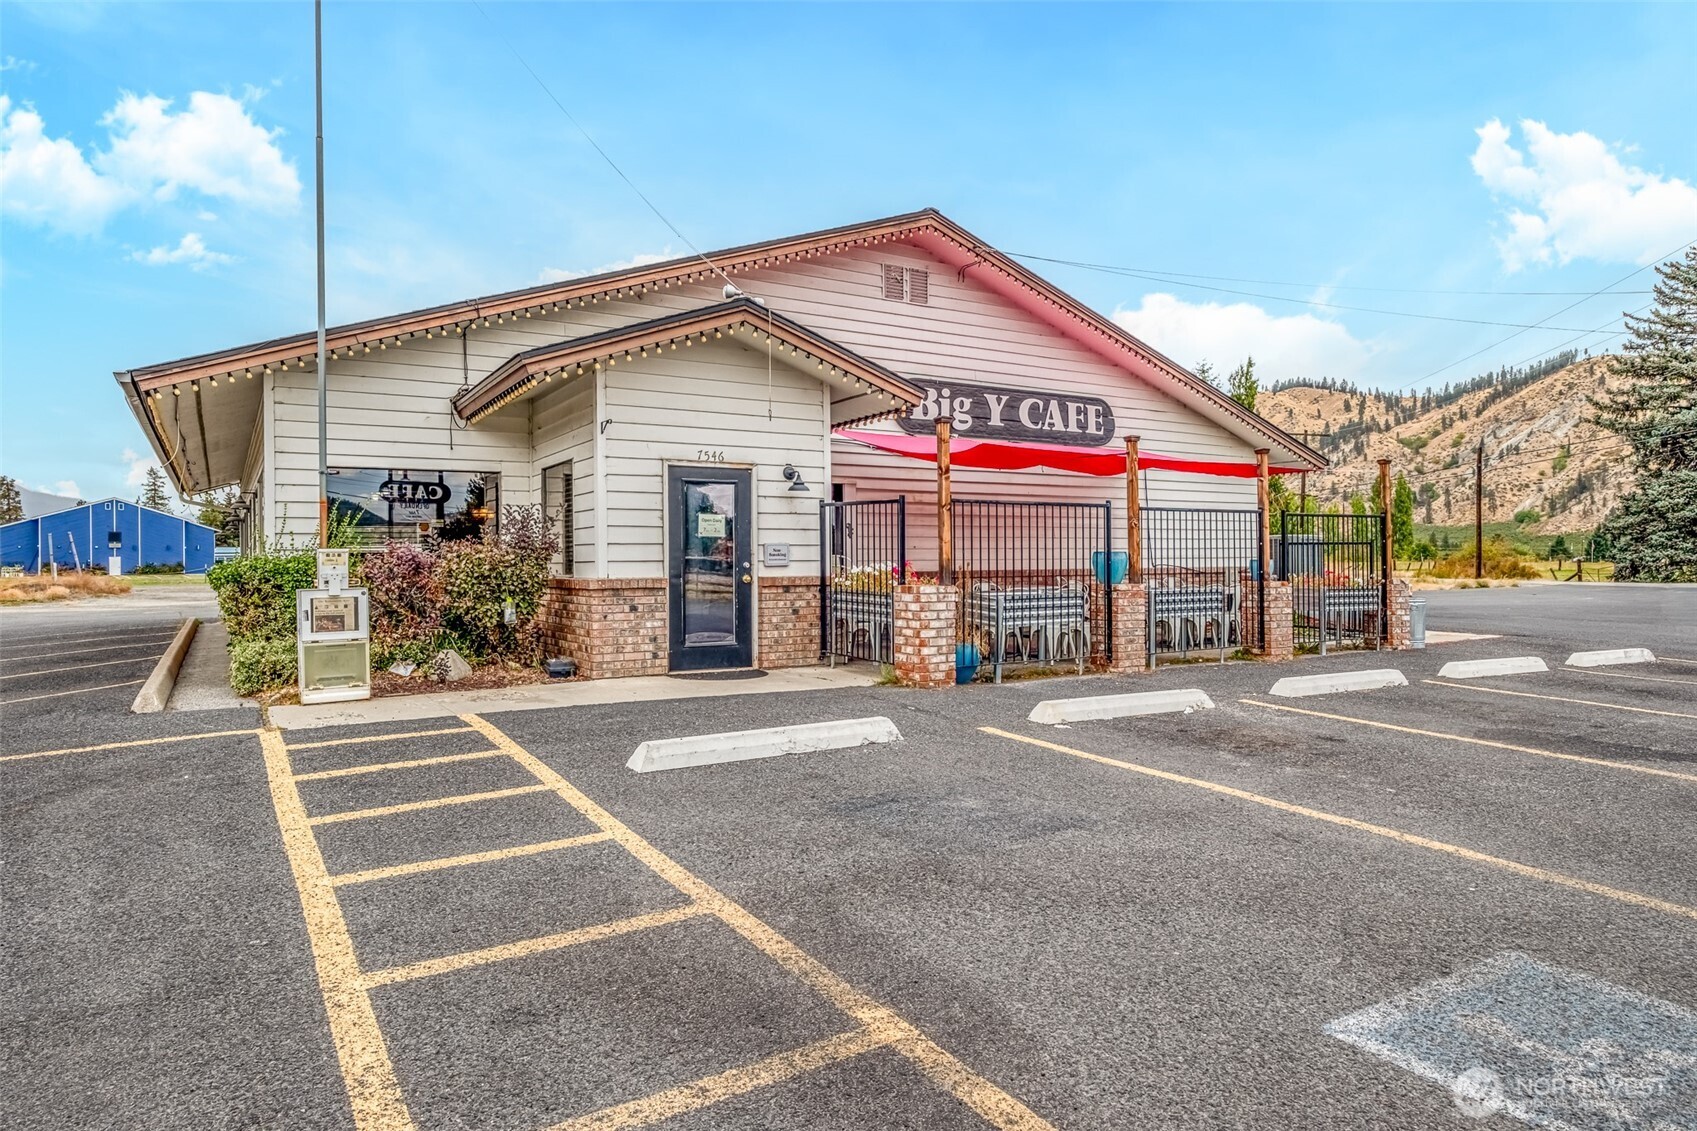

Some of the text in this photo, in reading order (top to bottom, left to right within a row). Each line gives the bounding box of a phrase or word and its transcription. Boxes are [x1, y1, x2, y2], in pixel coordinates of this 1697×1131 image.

[910, 387, 1104, 435] Big Y CAFE
[697, 450, 725, 462] 7546
